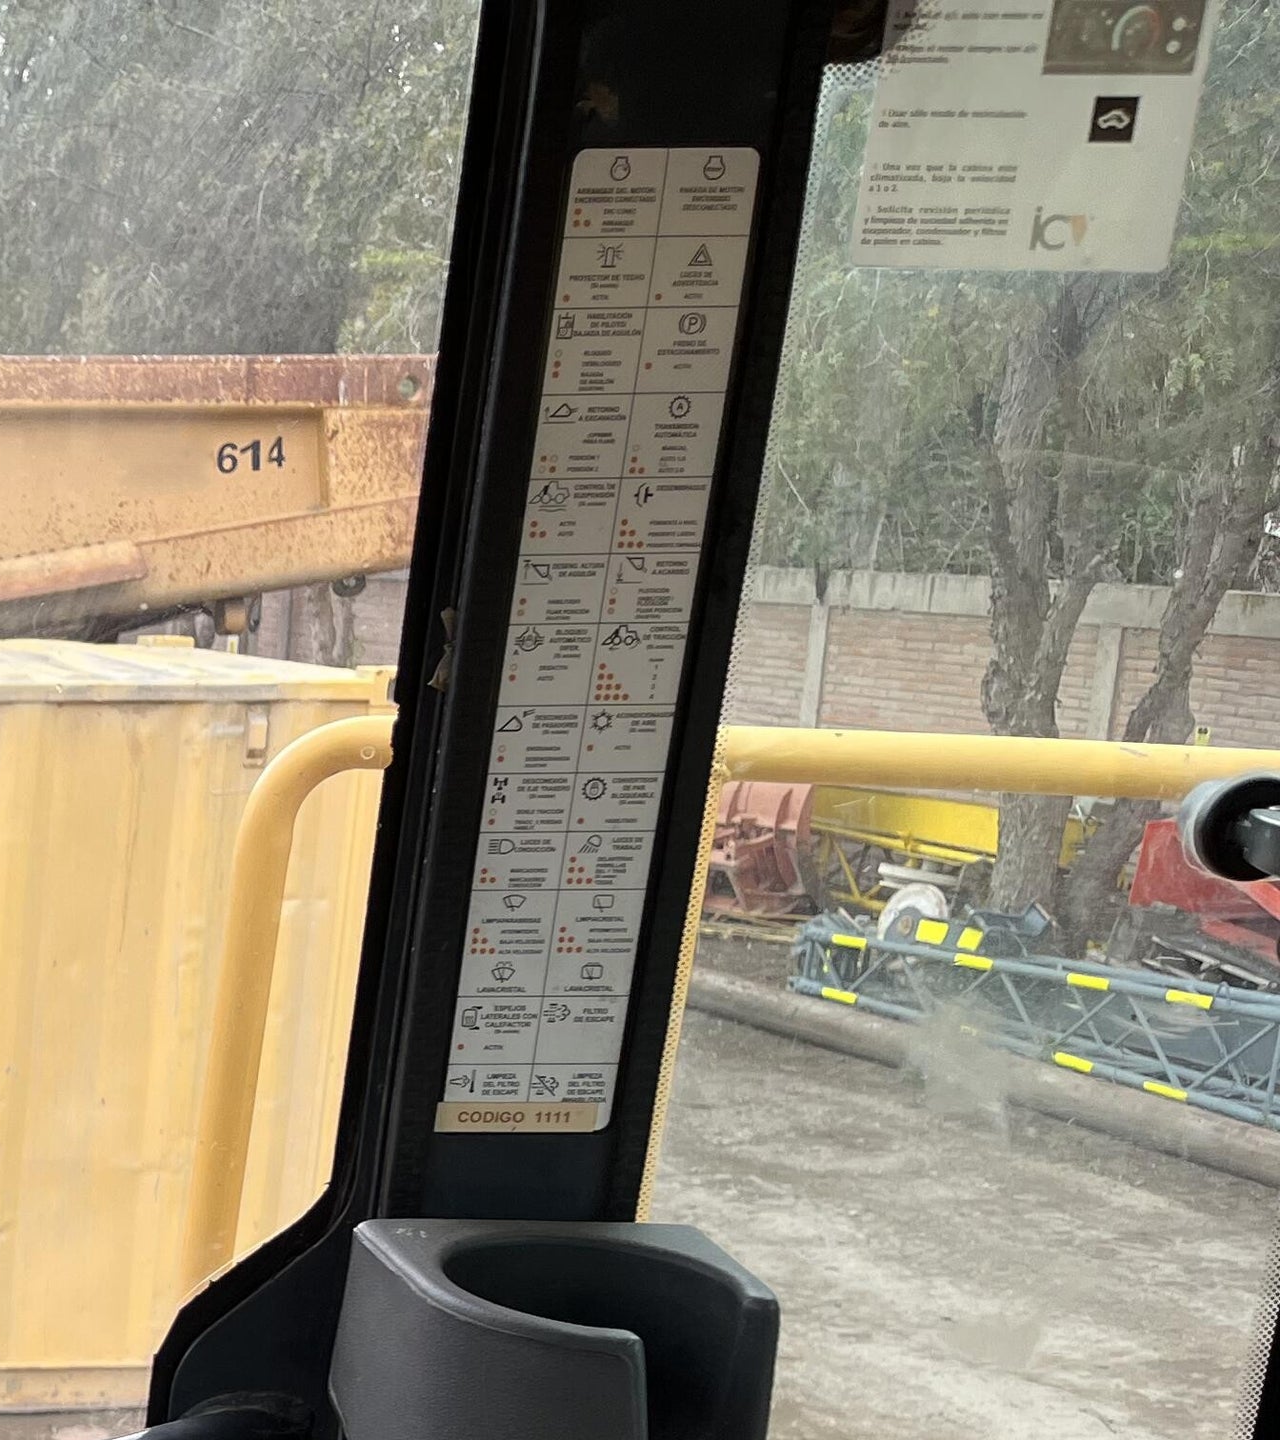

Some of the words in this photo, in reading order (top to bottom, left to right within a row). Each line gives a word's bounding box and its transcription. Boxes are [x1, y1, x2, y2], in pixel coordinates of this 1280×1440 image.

[217, 435, 286, 474] 614
[458, 1112, 525, 1123] CODIGO
[535, 1111, 571, 1123] 1111
